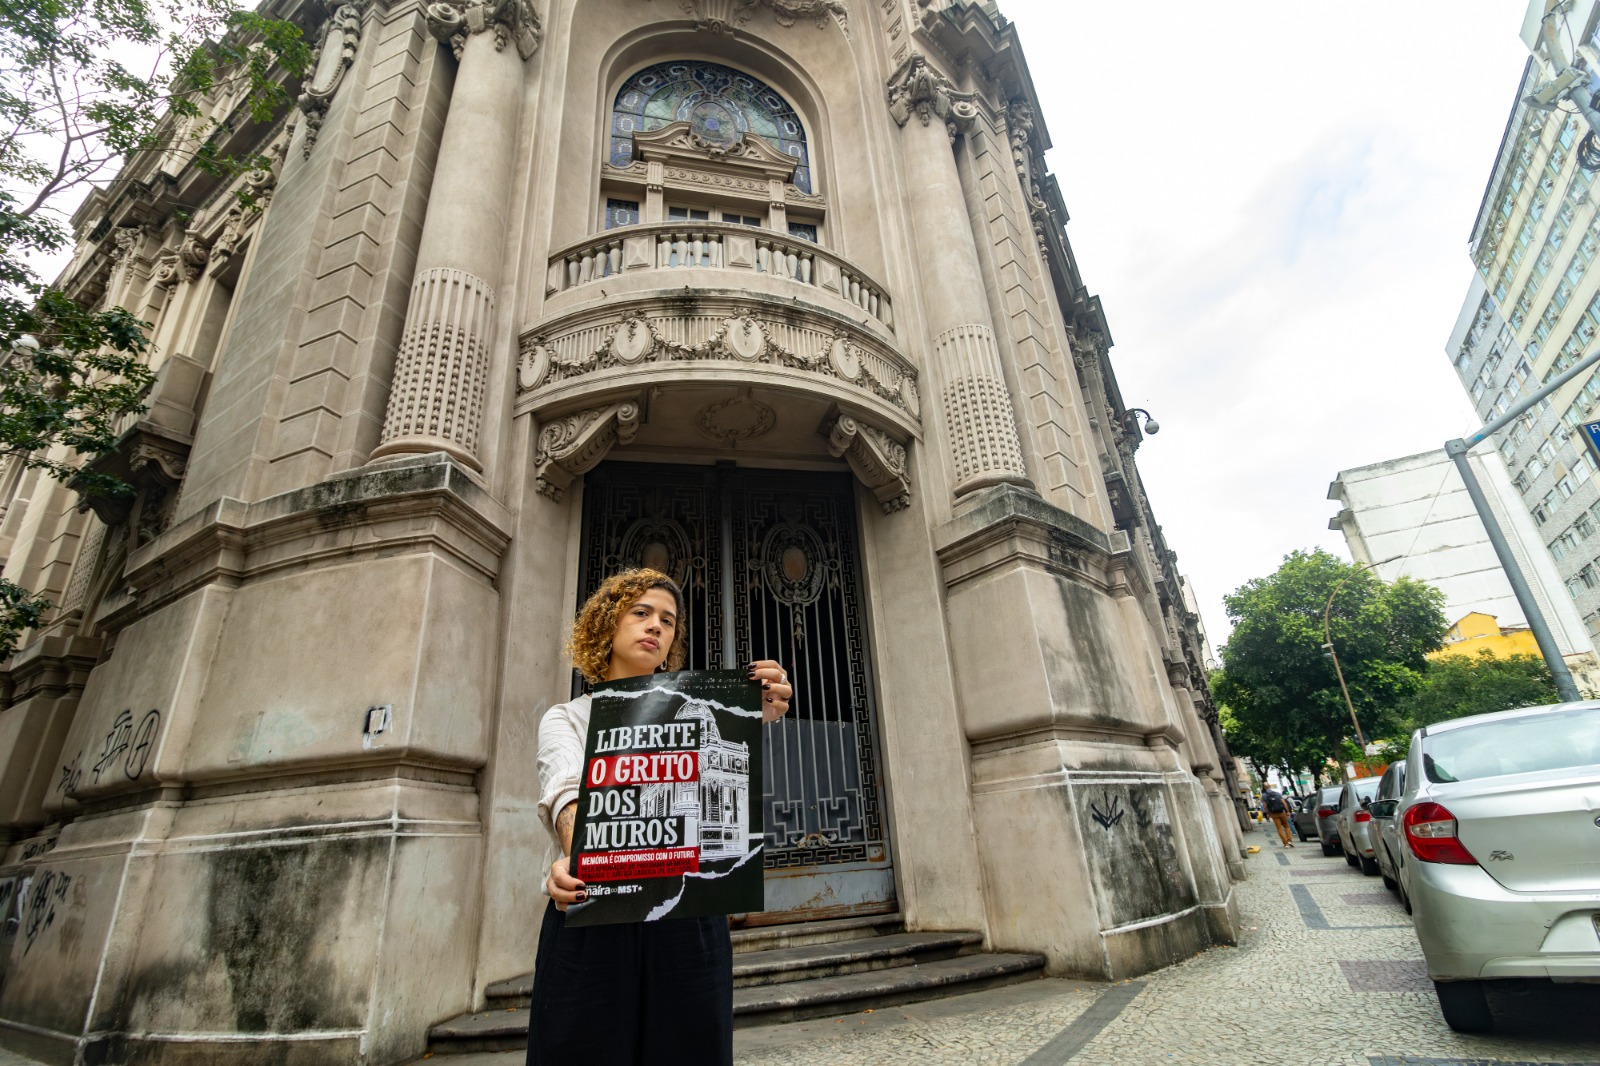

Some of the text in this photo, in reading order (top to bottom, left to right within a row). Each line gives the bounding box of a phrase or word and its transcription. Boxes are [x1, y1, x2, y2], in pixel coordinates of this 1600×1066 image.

[595, 723, 696, 753] LIBERTE
[591, 754, 694, 785] O GRITO
[587, 789, 636, 817] DOS
[584, 818, 678, 850] MUROS
[581, 850, 696, 866] MEMÓRIA É COMPROMISSO COM O FUTURO.
[617, 885, 639, 894] MST
